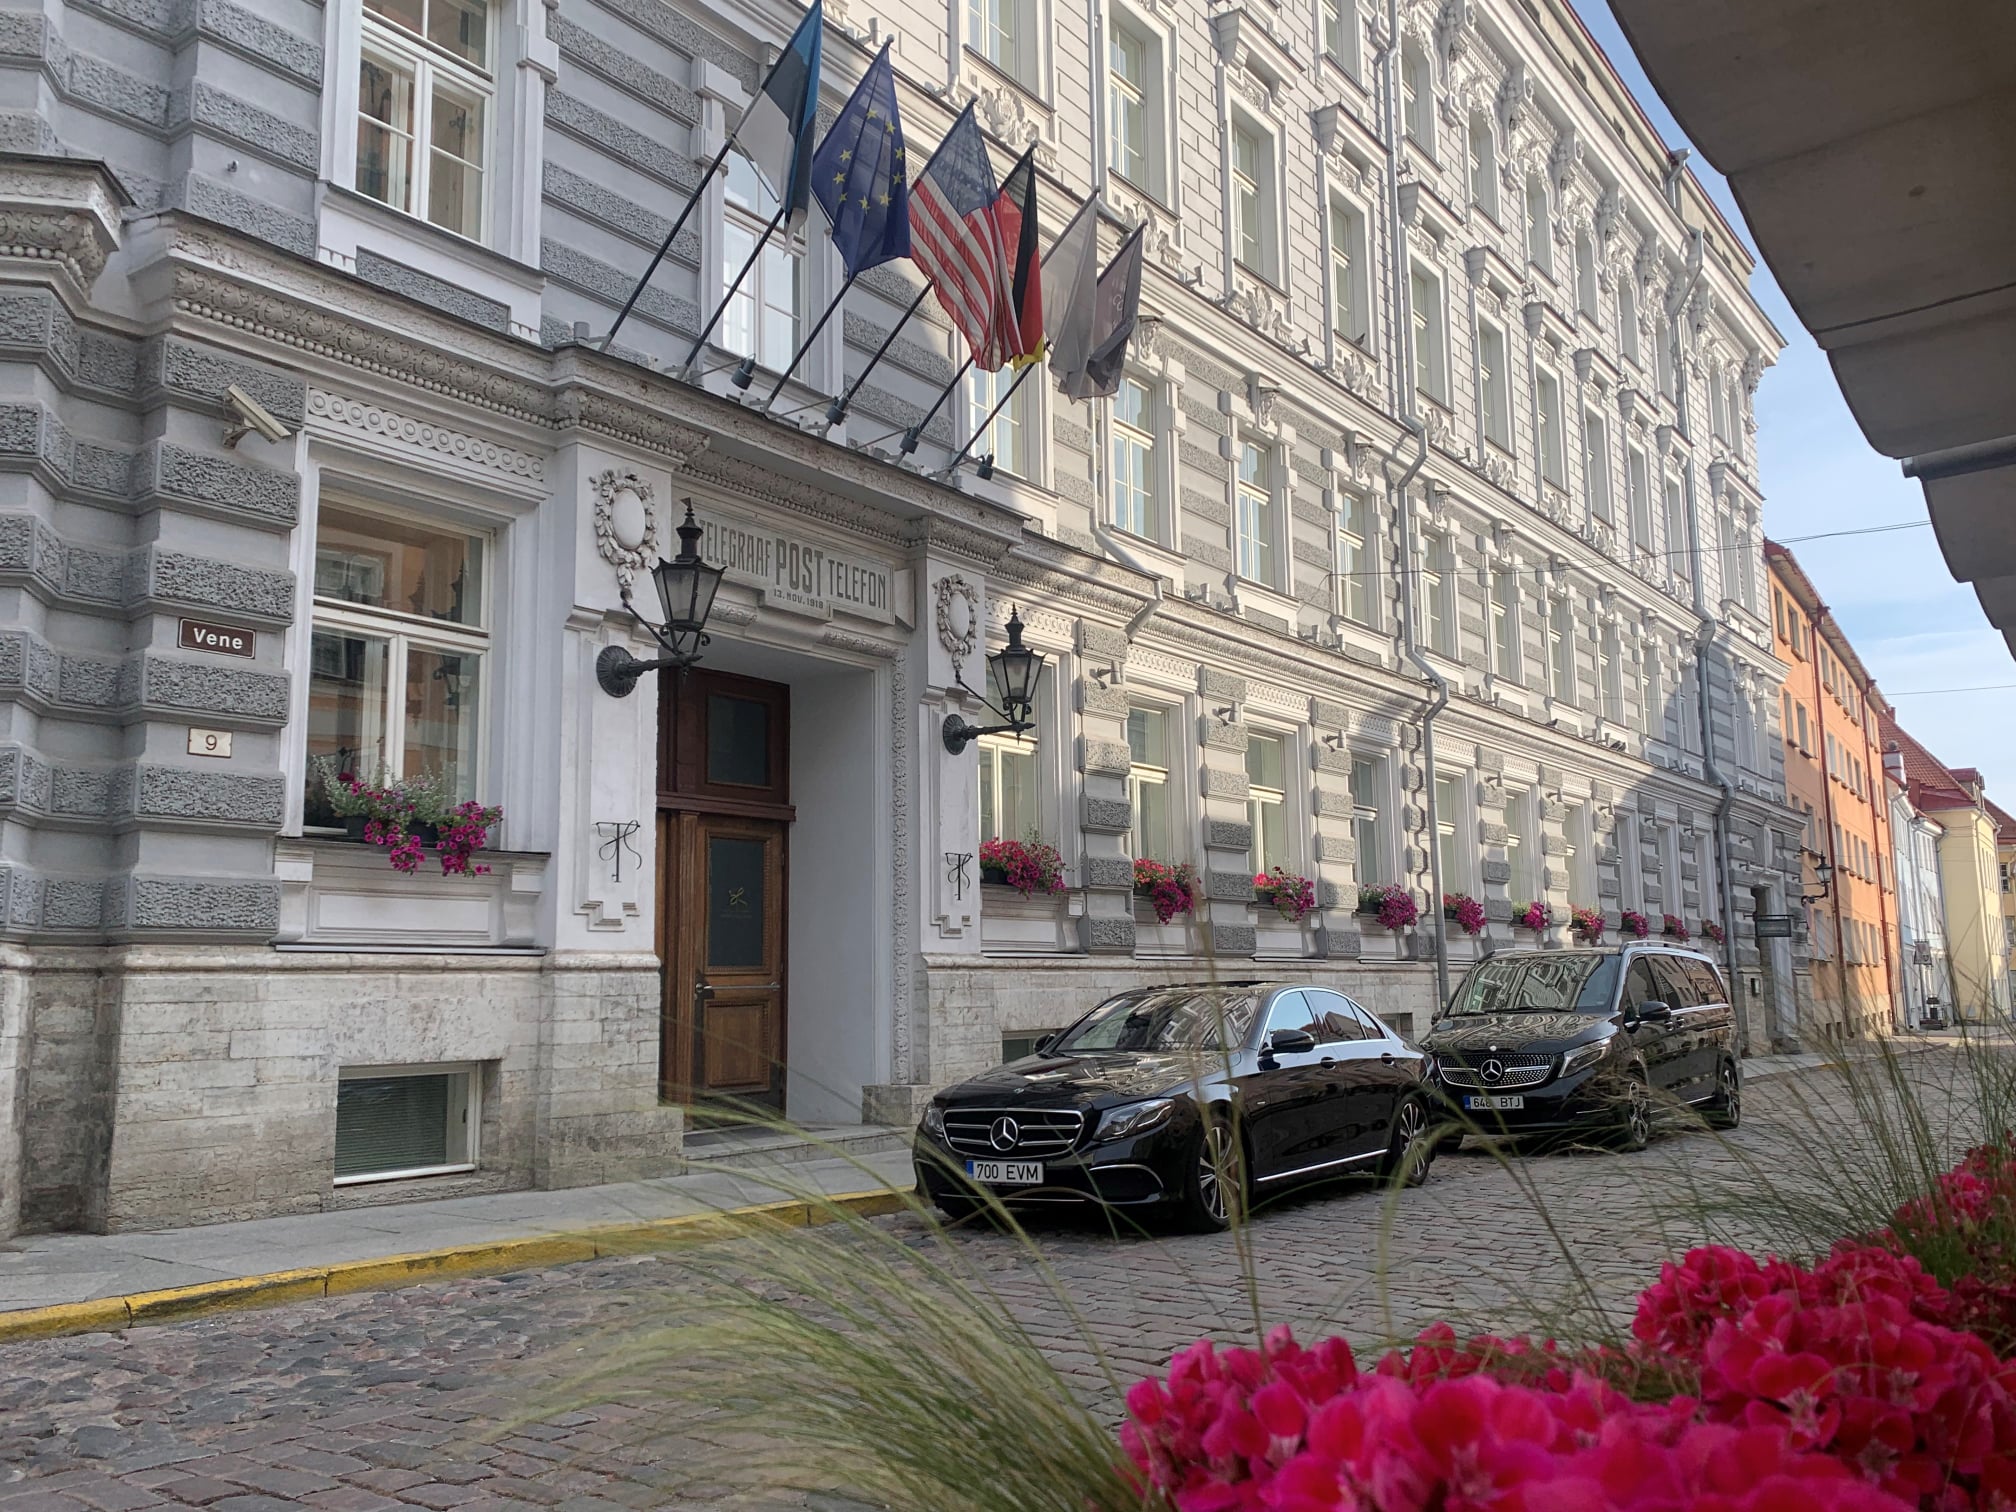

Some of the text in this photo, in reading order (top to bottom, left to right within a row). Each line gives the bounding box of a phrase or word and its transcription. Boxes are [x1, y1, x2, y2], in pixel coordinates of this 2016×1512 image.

[699, 520, 886, 610] TELEGRAAF POST TELEFON
[193, 627, 243, 650] Vene
[205, 734, 218, 751] 9
[1500, 1097, 1520, 1108] BTJ
[977, 1164, 1038, 1180] 700 EVM
